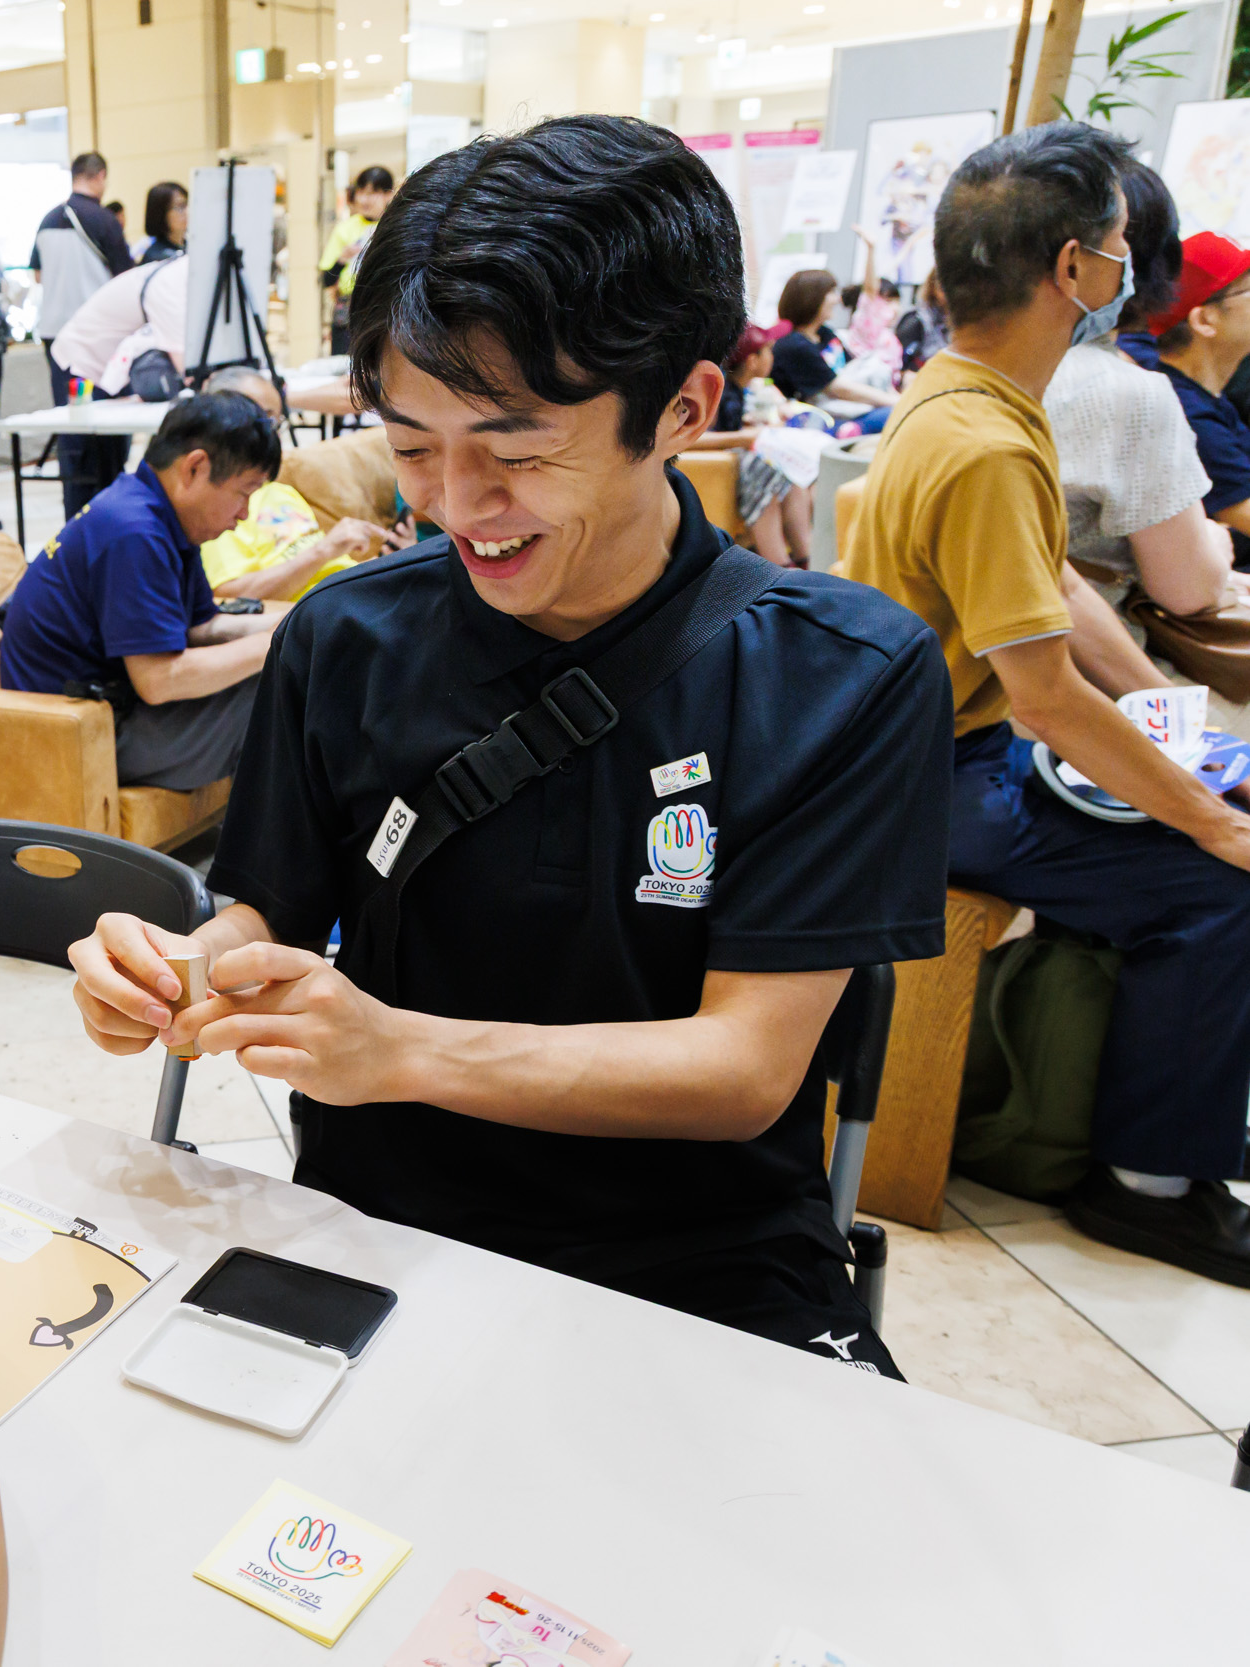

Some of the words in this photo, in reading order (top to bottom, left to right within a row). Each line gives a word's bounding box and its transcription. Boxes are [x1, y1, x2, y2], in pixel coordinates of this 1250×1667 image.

[386, 808, 407, 845] 68
[645, 880, 686, 893] TOKYO
[655, 894, 680, 902] SUMMER
[246, 1562, 288, 1588] TOKYO
[290, 1584, 323, 1605] 2025
[251, 1576, 277, 1594] SUMMER
[276, 1591, 317, 1614] DEAFLYMPICS
